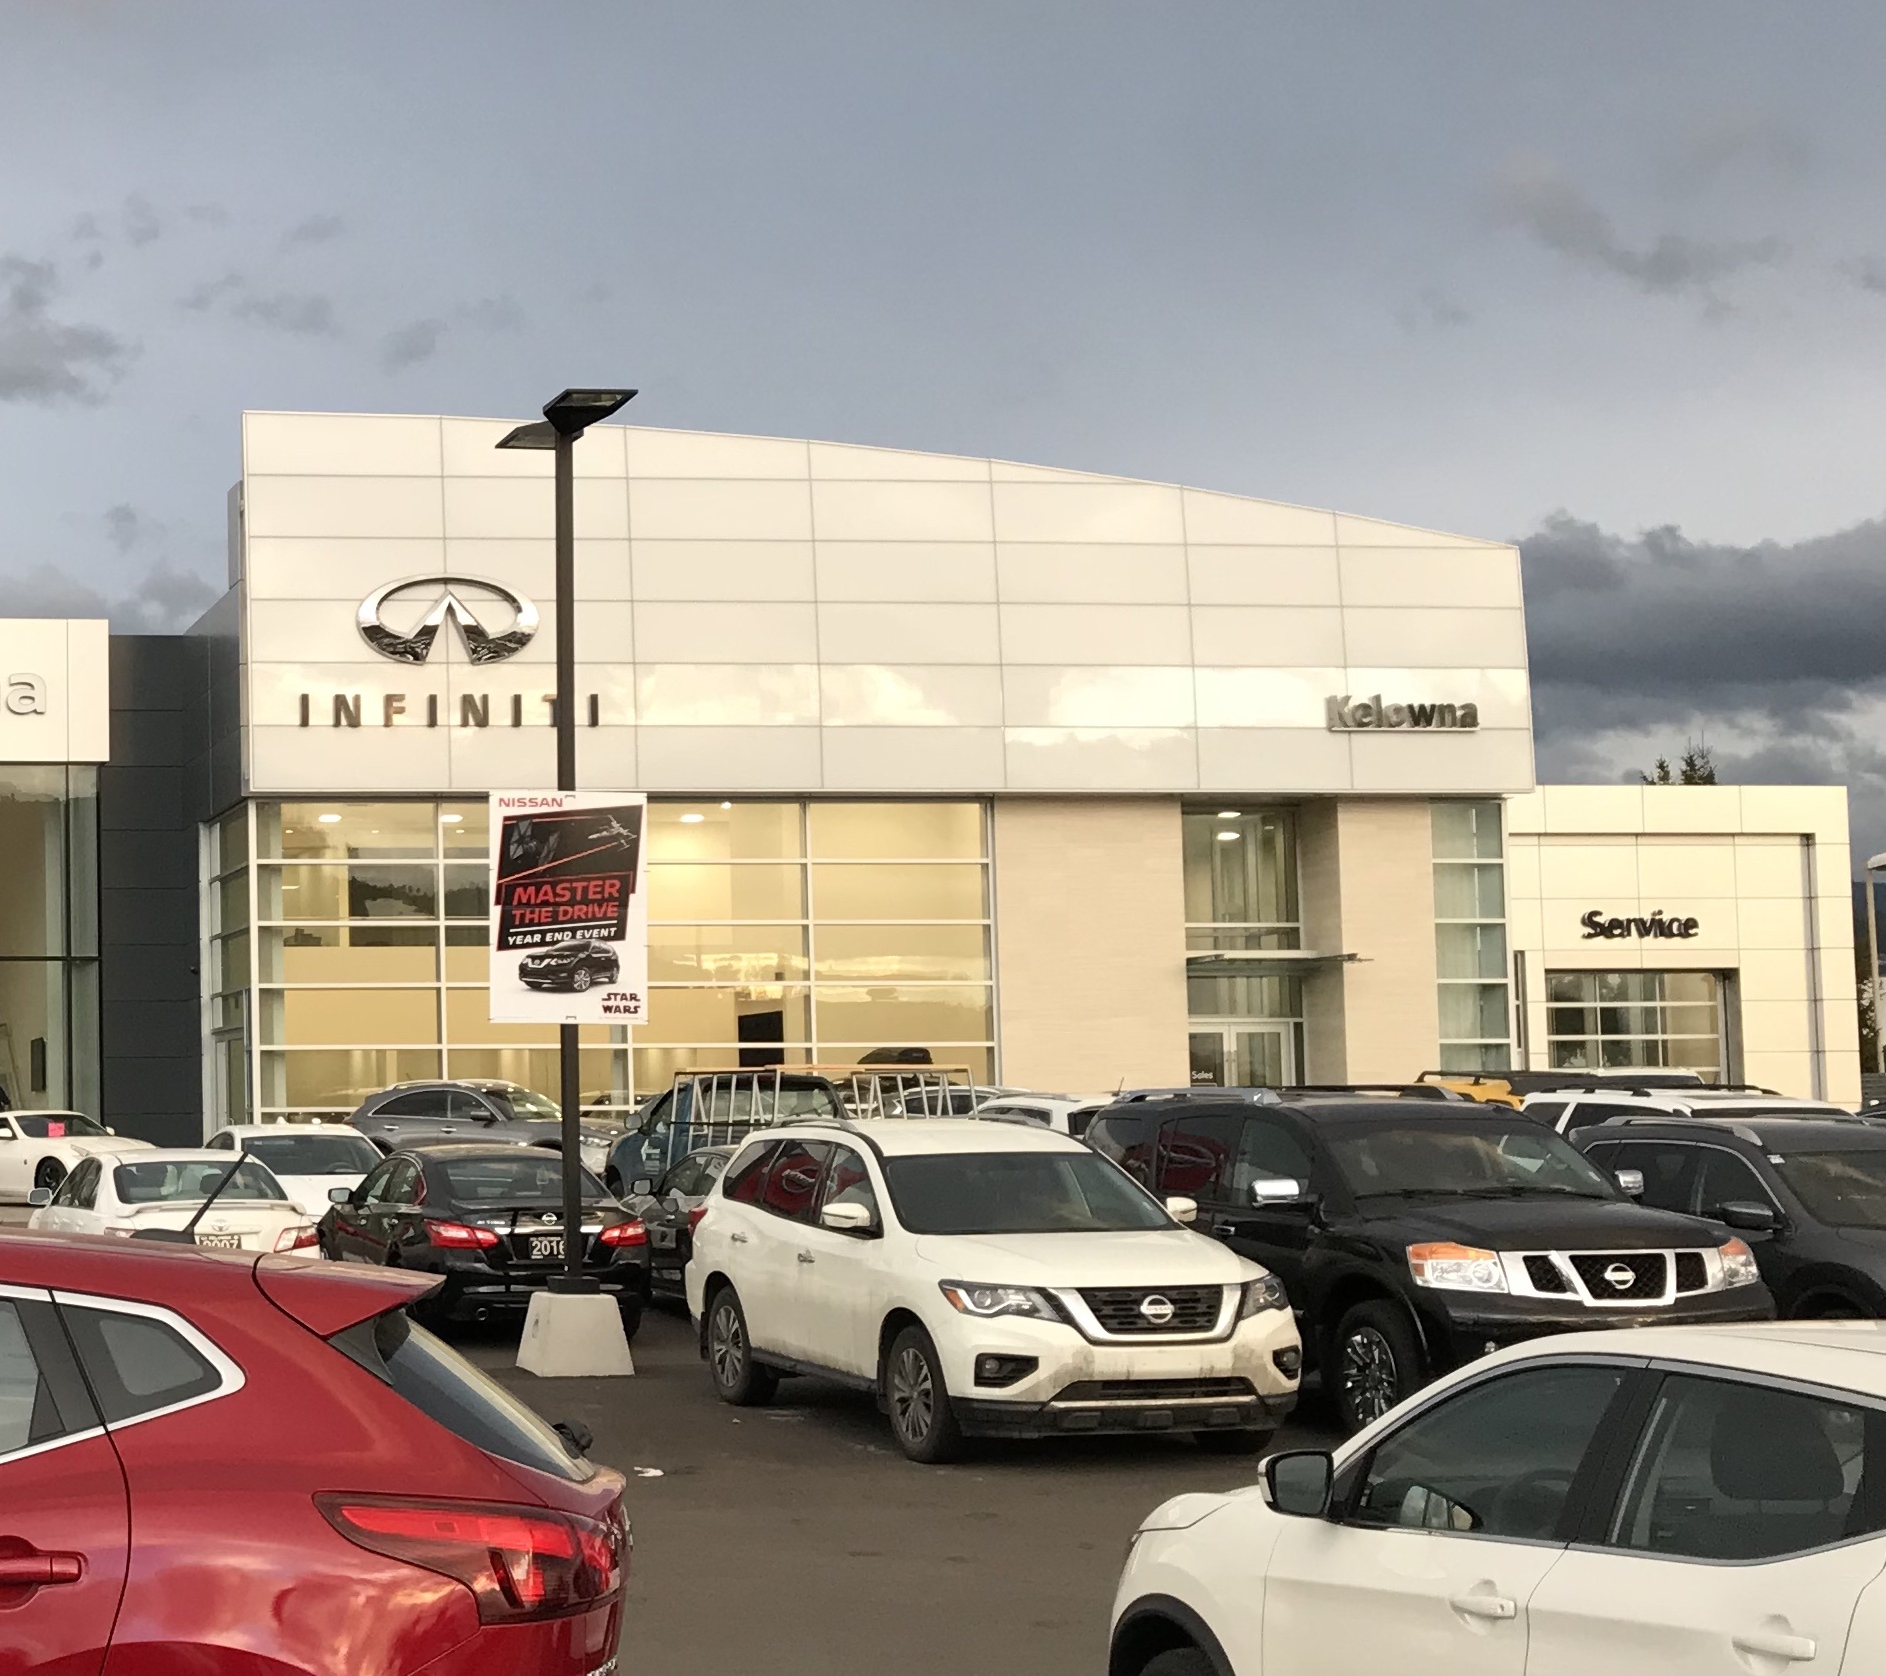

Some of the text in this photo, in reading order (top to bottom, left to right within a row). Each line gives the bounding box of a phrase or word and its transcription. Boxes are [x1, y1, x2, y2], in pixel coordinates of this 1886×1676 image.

[1324, 693, 1481, 729] Kelowna
[498, 797, 564, 808] NISSAN
[512, 879, 622, 906] MASTER
[511, 901, 620, 925] THE DRIVE
[1580, 909, 1700, 940] Service
[507, 927, 618, 946] YEAR END EVENT
[601, 992, 641, 1002] STAR
[601, 1004, 641, 1015] WARS
[1191, 1070, 1214, 1080] Sales
